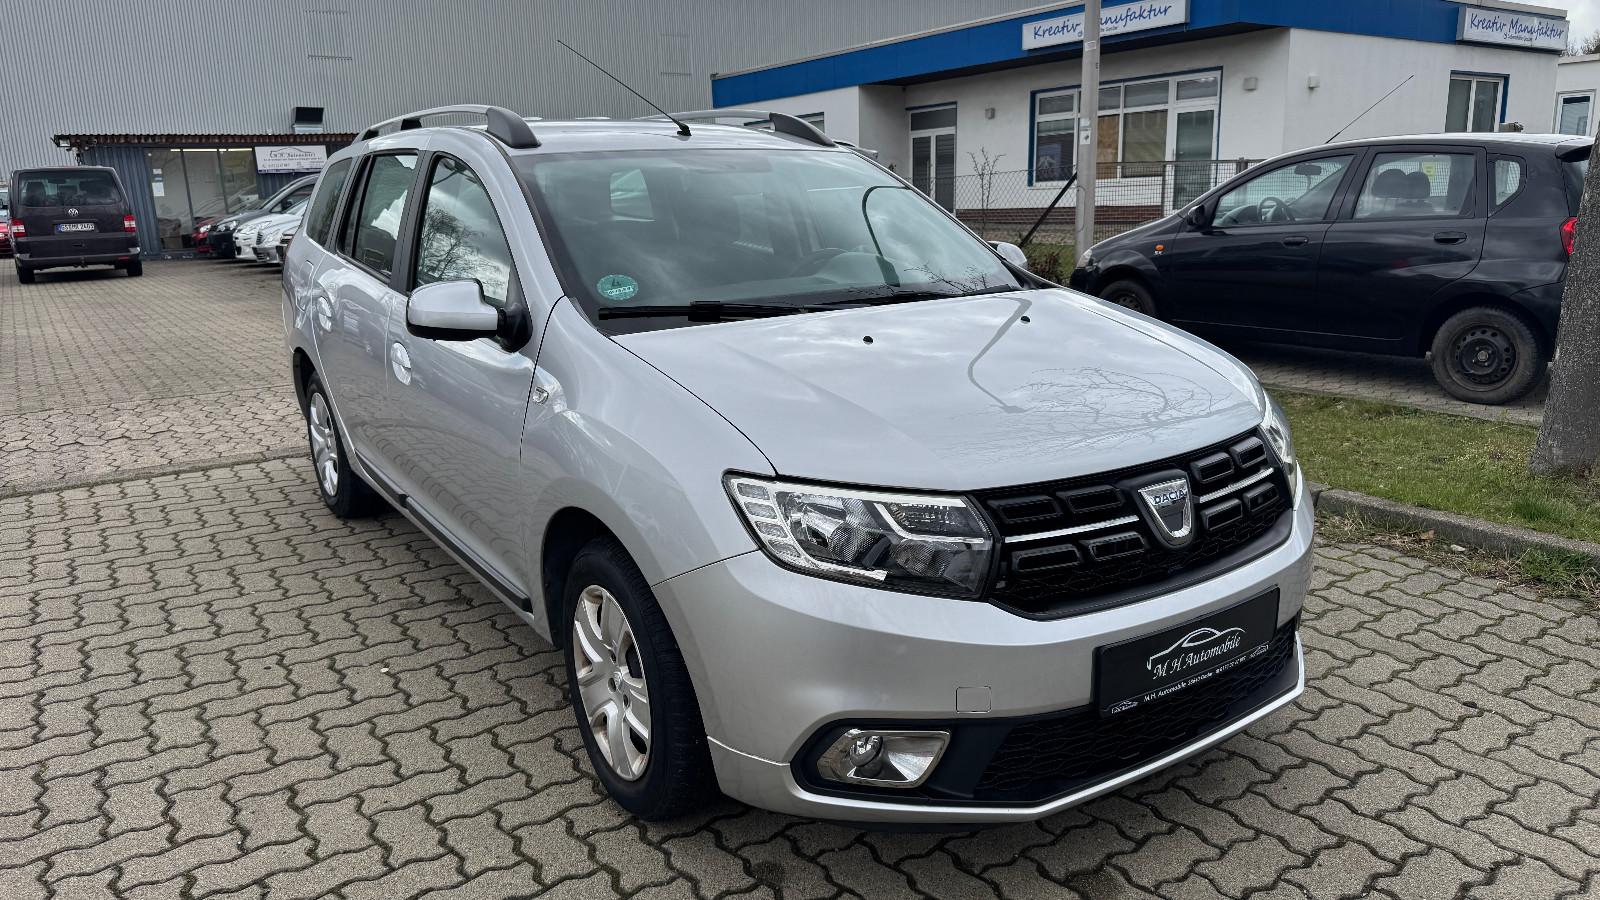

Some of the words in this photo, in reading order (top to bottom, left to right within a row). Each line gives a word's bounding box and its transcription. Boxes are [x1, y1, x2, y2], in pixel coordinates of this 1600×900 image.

[1033, 18, 1080, 39] Kreativ
[1100, 5, 1172, 27] anufaktur
[1470, 13, 1506, 32] Kreativ
[1509, 18, 1565, 41] Manufaktur
[1153, 489, 1185, 504] DACIA
[1152, 659, 1170, 680] M
[1170, 653, 1185, 674] H
[1183, 632, 1241, 668] Automobile
